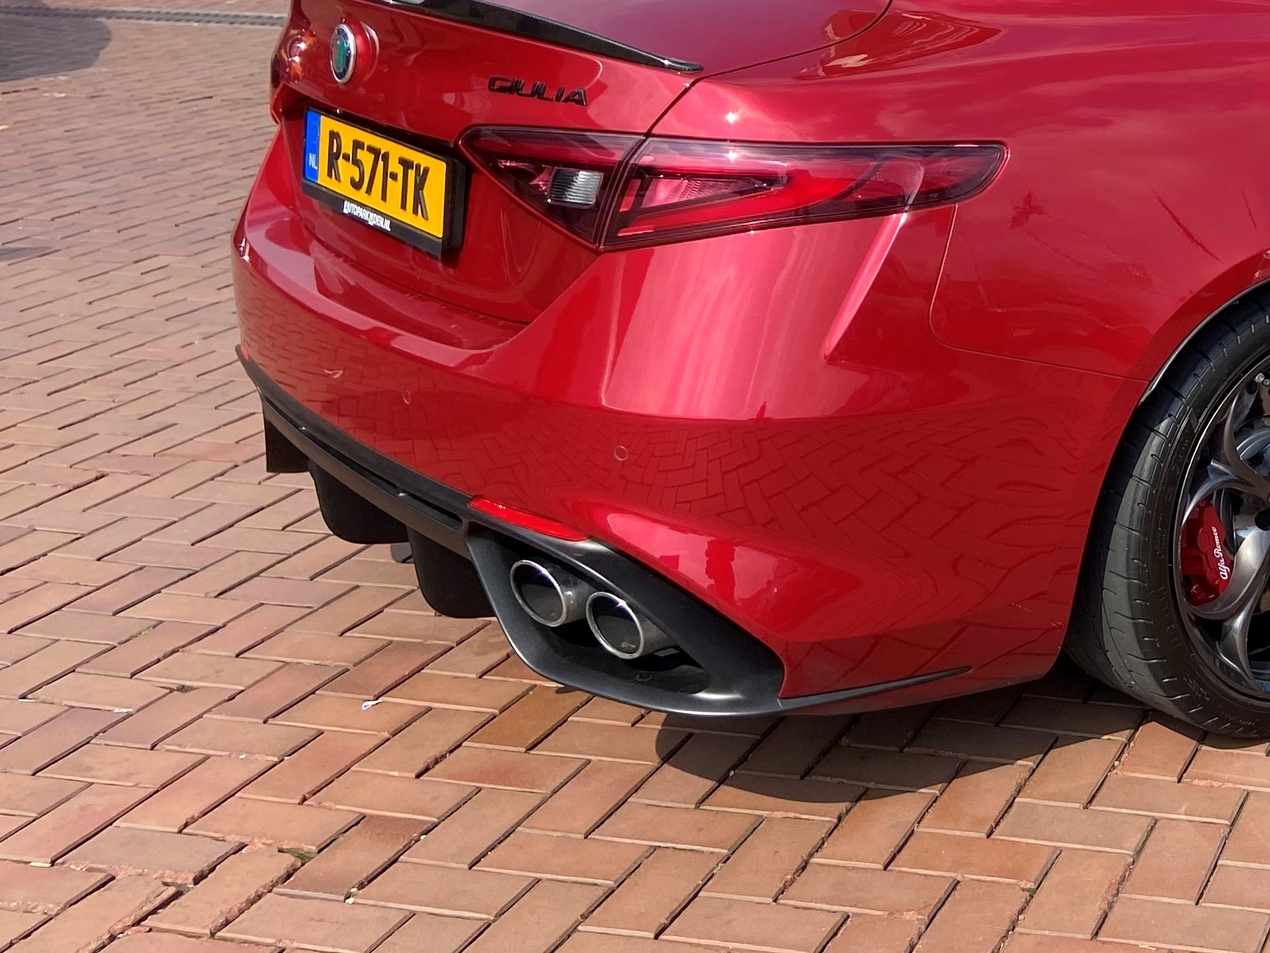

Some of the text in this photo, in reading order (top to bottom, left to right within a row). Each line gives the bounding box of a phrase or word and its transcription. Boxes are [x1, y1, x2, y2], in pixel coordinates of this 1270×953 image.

[488, 76, 588, 107] GIULIA
[308, 152, 318, 170] NL
[327, 129, 430, 221] R-571-TK
[1211, 525, 1231, 580] Alfa Romeo
